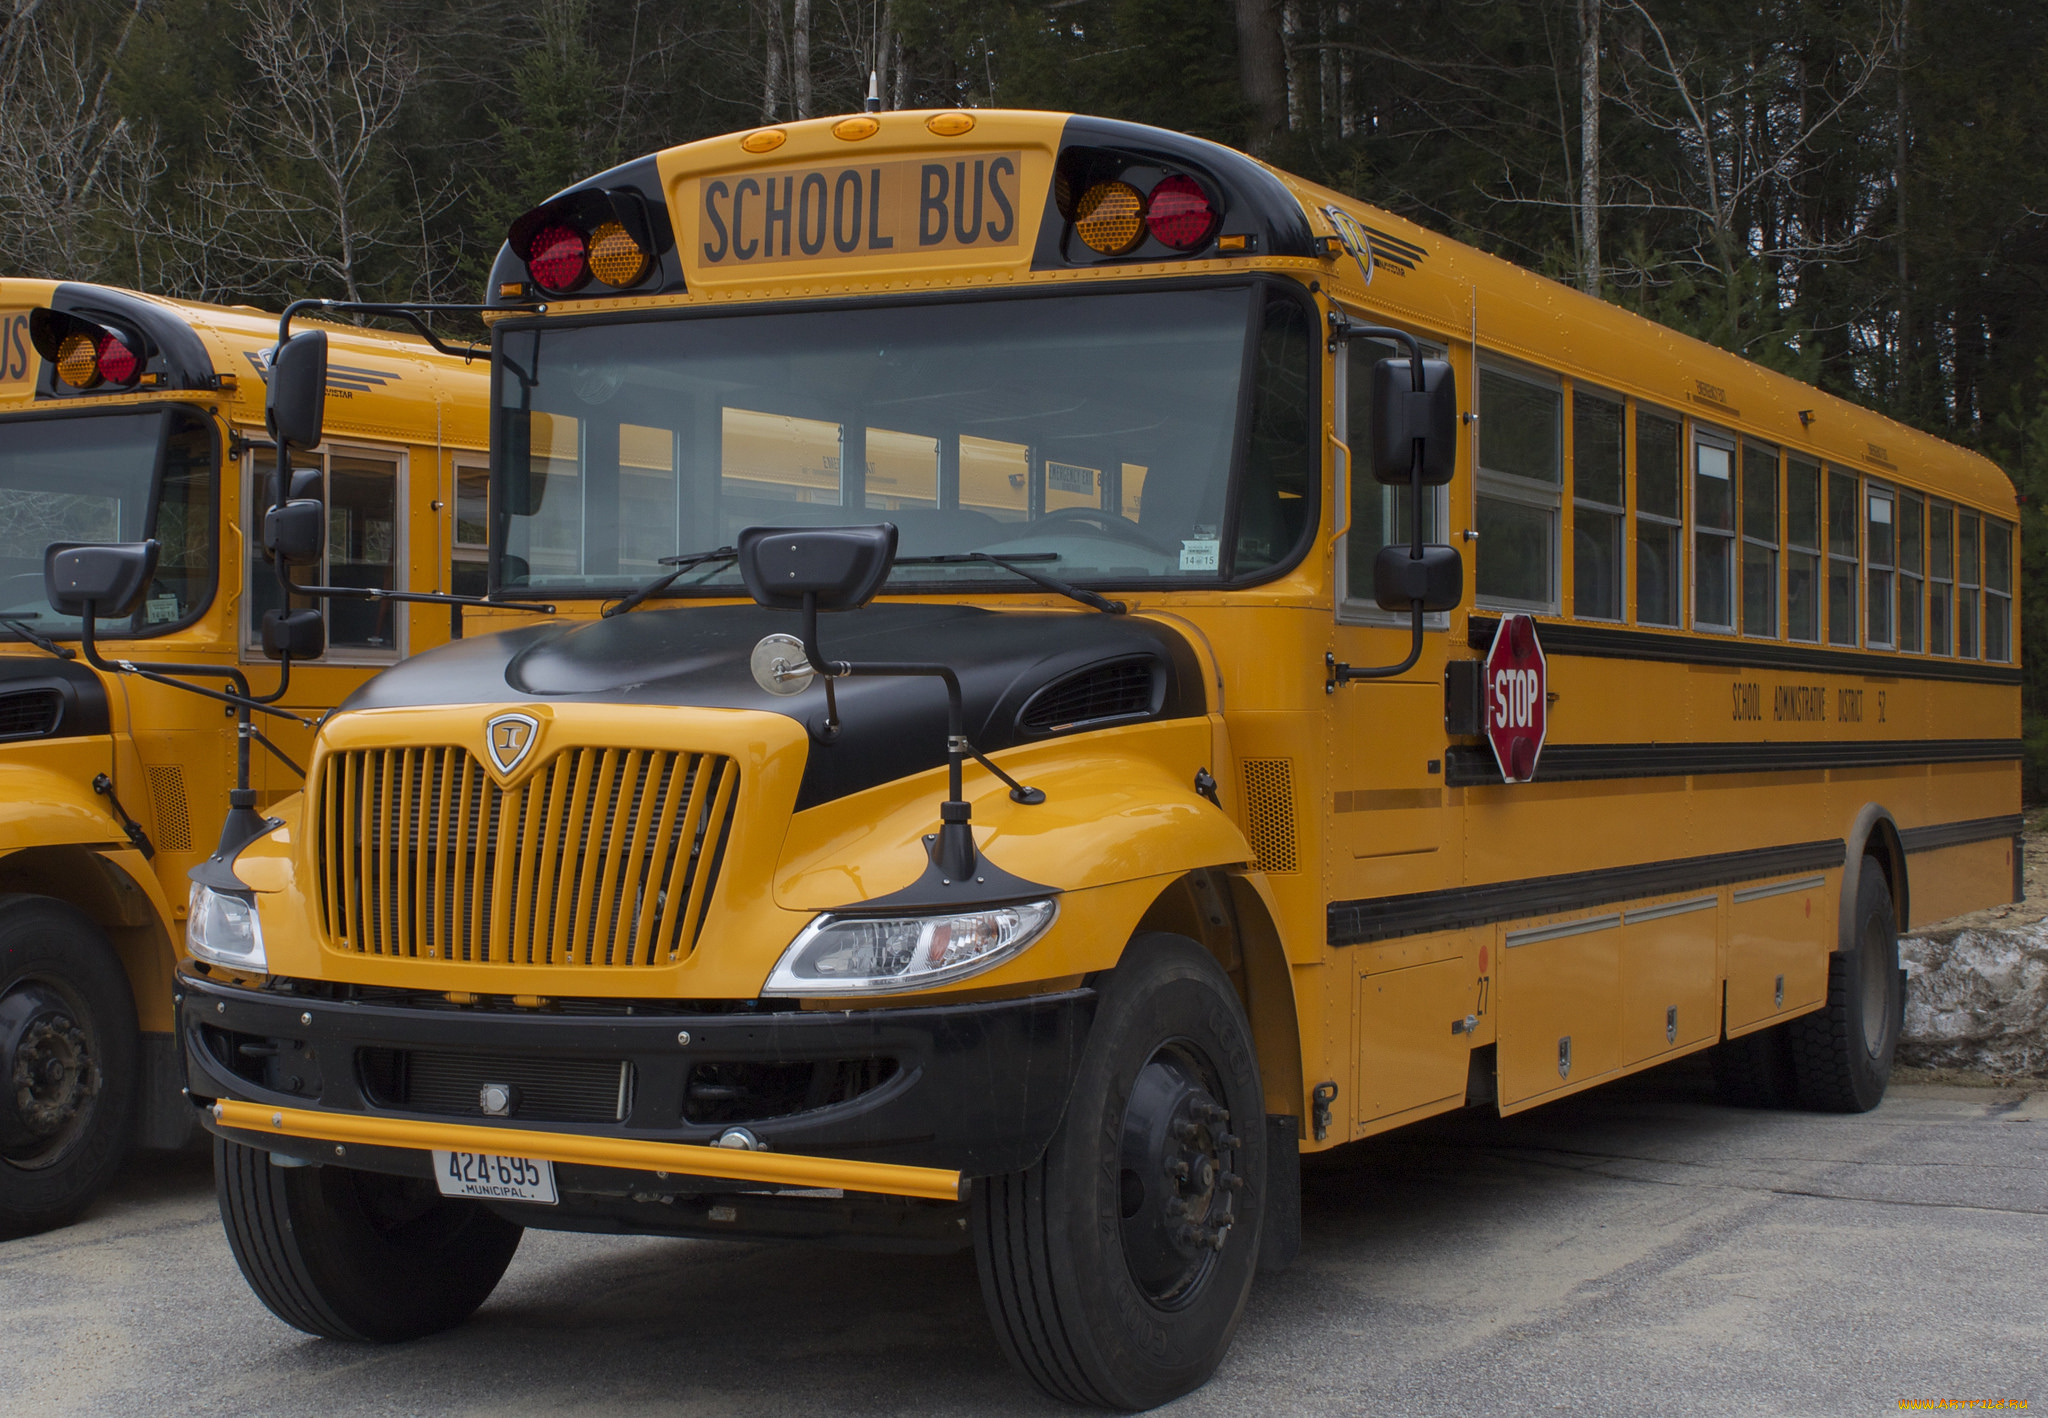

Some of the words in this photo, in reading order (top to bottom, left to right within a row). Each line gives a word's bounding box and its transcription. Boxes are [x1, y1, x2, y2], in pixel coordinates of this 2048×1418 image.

[703, 168, 894, 263] SCHOOL
[918, 156, 1015, 247] BUS
[325, 388, 353, 400] VISTAR
[1185, 556, 1195, 565] 14
[1205, 556, 1215, 565] 15
[1495, 668, 1539, 728] STOP
[1733, 682, 1762, 721] SCHOOL
[1774, 684, 1826, 722] ADMINISTRATIVE
[1838, 688, 1863, 722] DISTRICT
[1878, 690, 1886, 723] 52
[1477, 976, 1490, 1016] 27
[466, 1183, 528, 1198] MUNICIPAL
